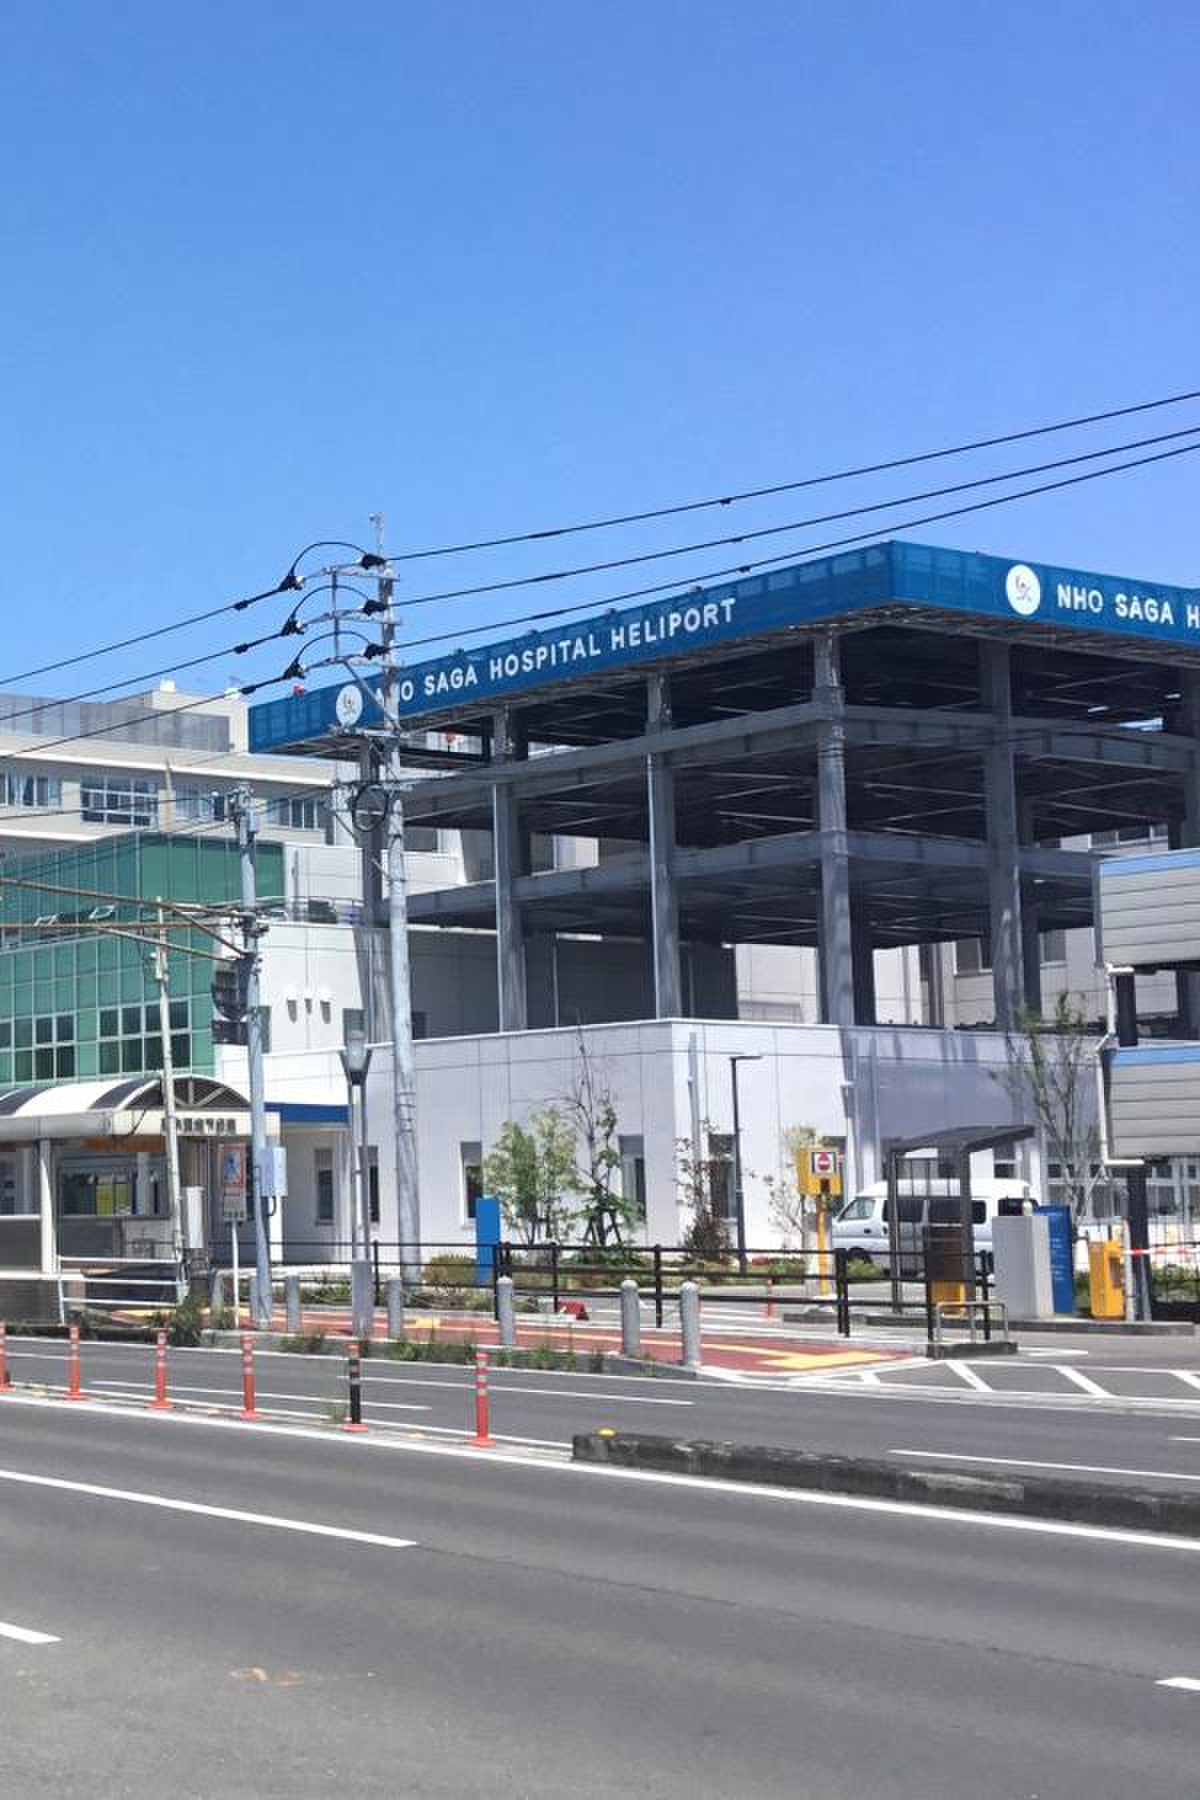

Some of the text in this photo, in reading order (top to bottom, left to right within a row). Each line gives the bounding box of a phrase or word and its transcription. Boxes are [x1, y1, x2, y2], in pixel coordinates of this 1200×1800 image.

[1057, 583, 1104, 614] NHO
[1114, 593, 1175, 625] SAGA
[423, 664, 478, 696] SAGA
[490, 634, 601, 681] HOSPITAL
[610, 598, 735, 651] HELIPORT
